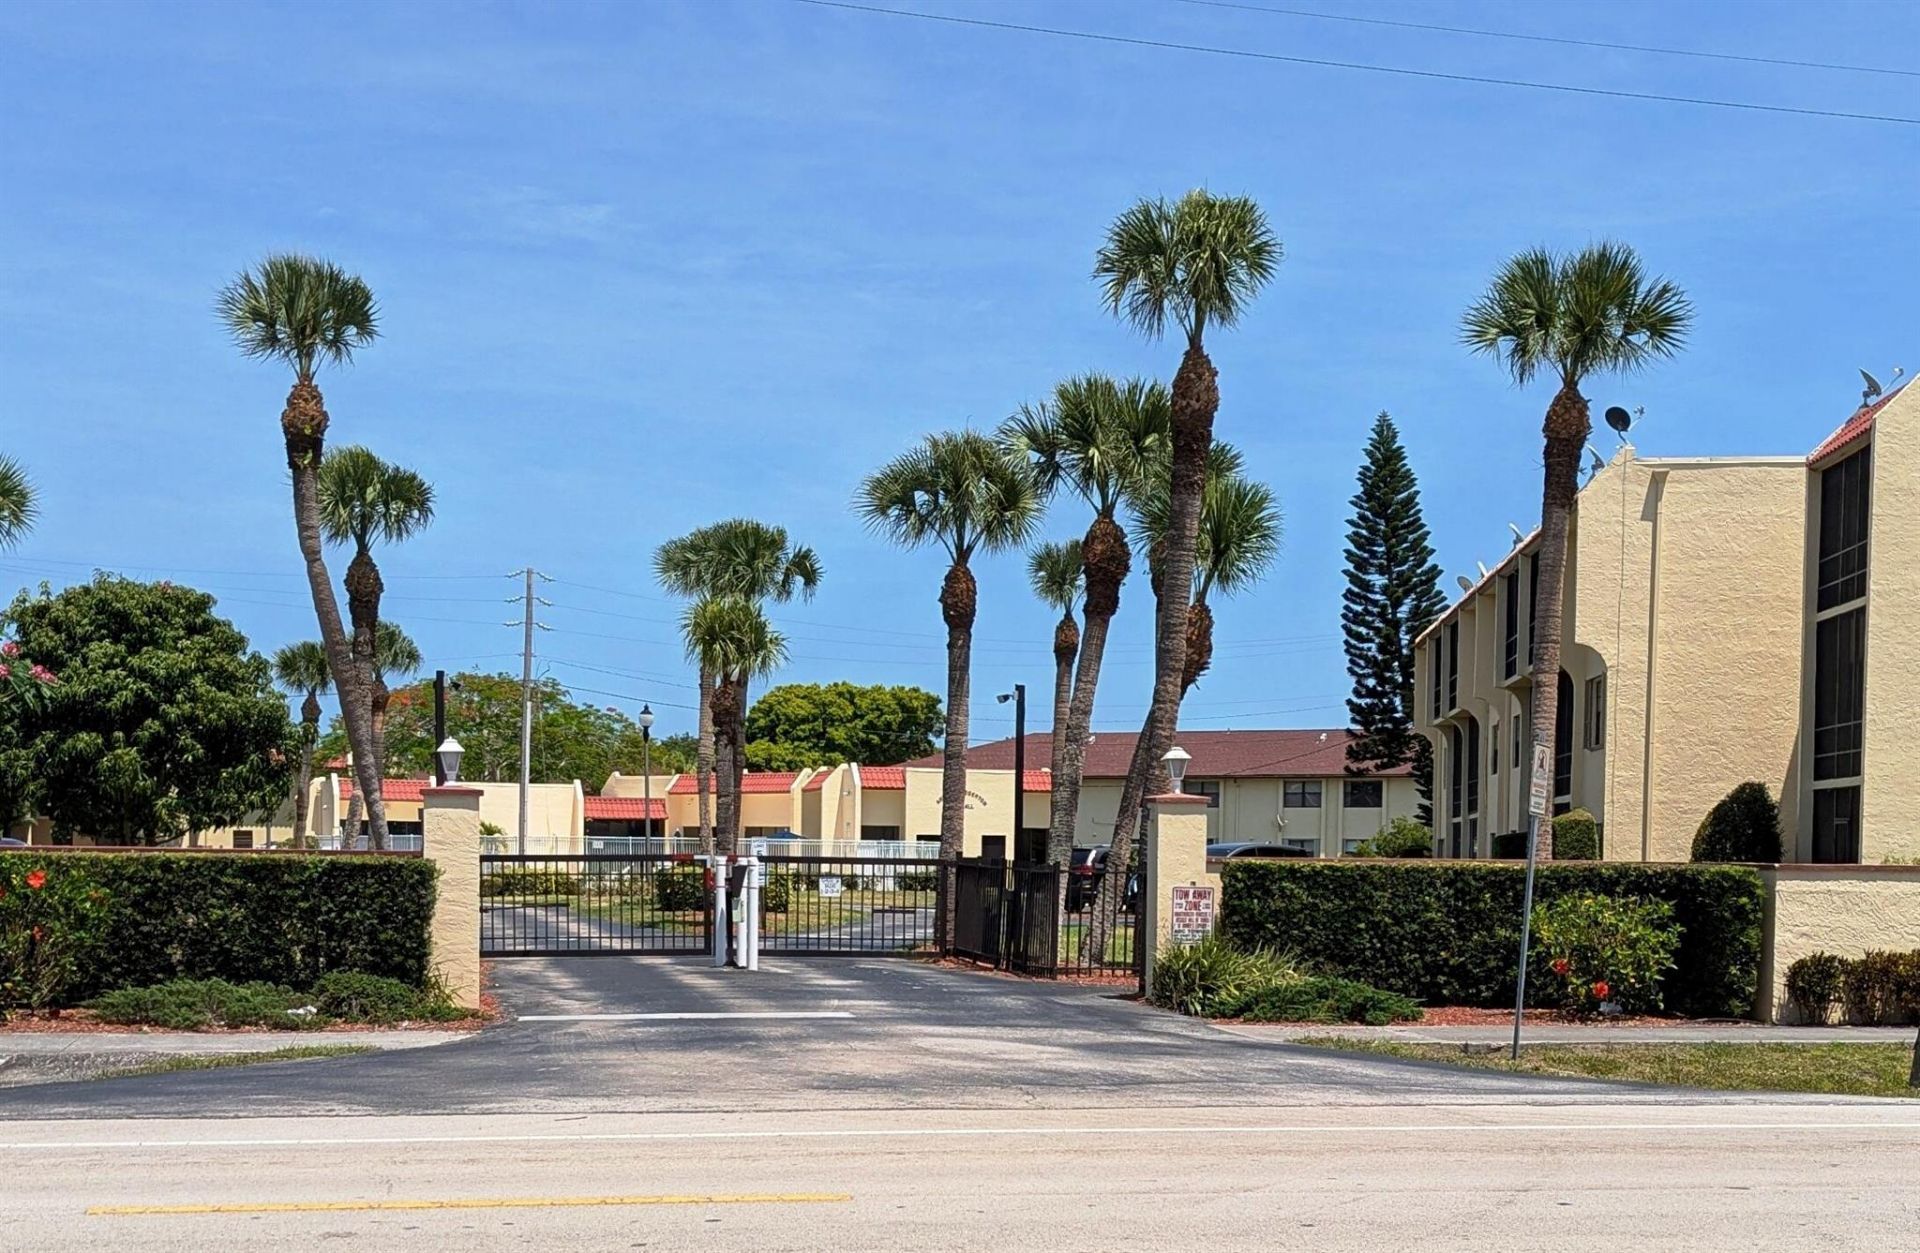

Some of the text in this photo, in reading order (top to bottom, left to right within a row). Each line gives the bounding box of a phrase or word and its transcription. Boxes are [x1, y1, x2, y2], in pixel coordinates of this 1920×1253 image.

[1175, 889, 1212, 900] TOW AWAY
[1184, 901, 1202, 911] ZONE
